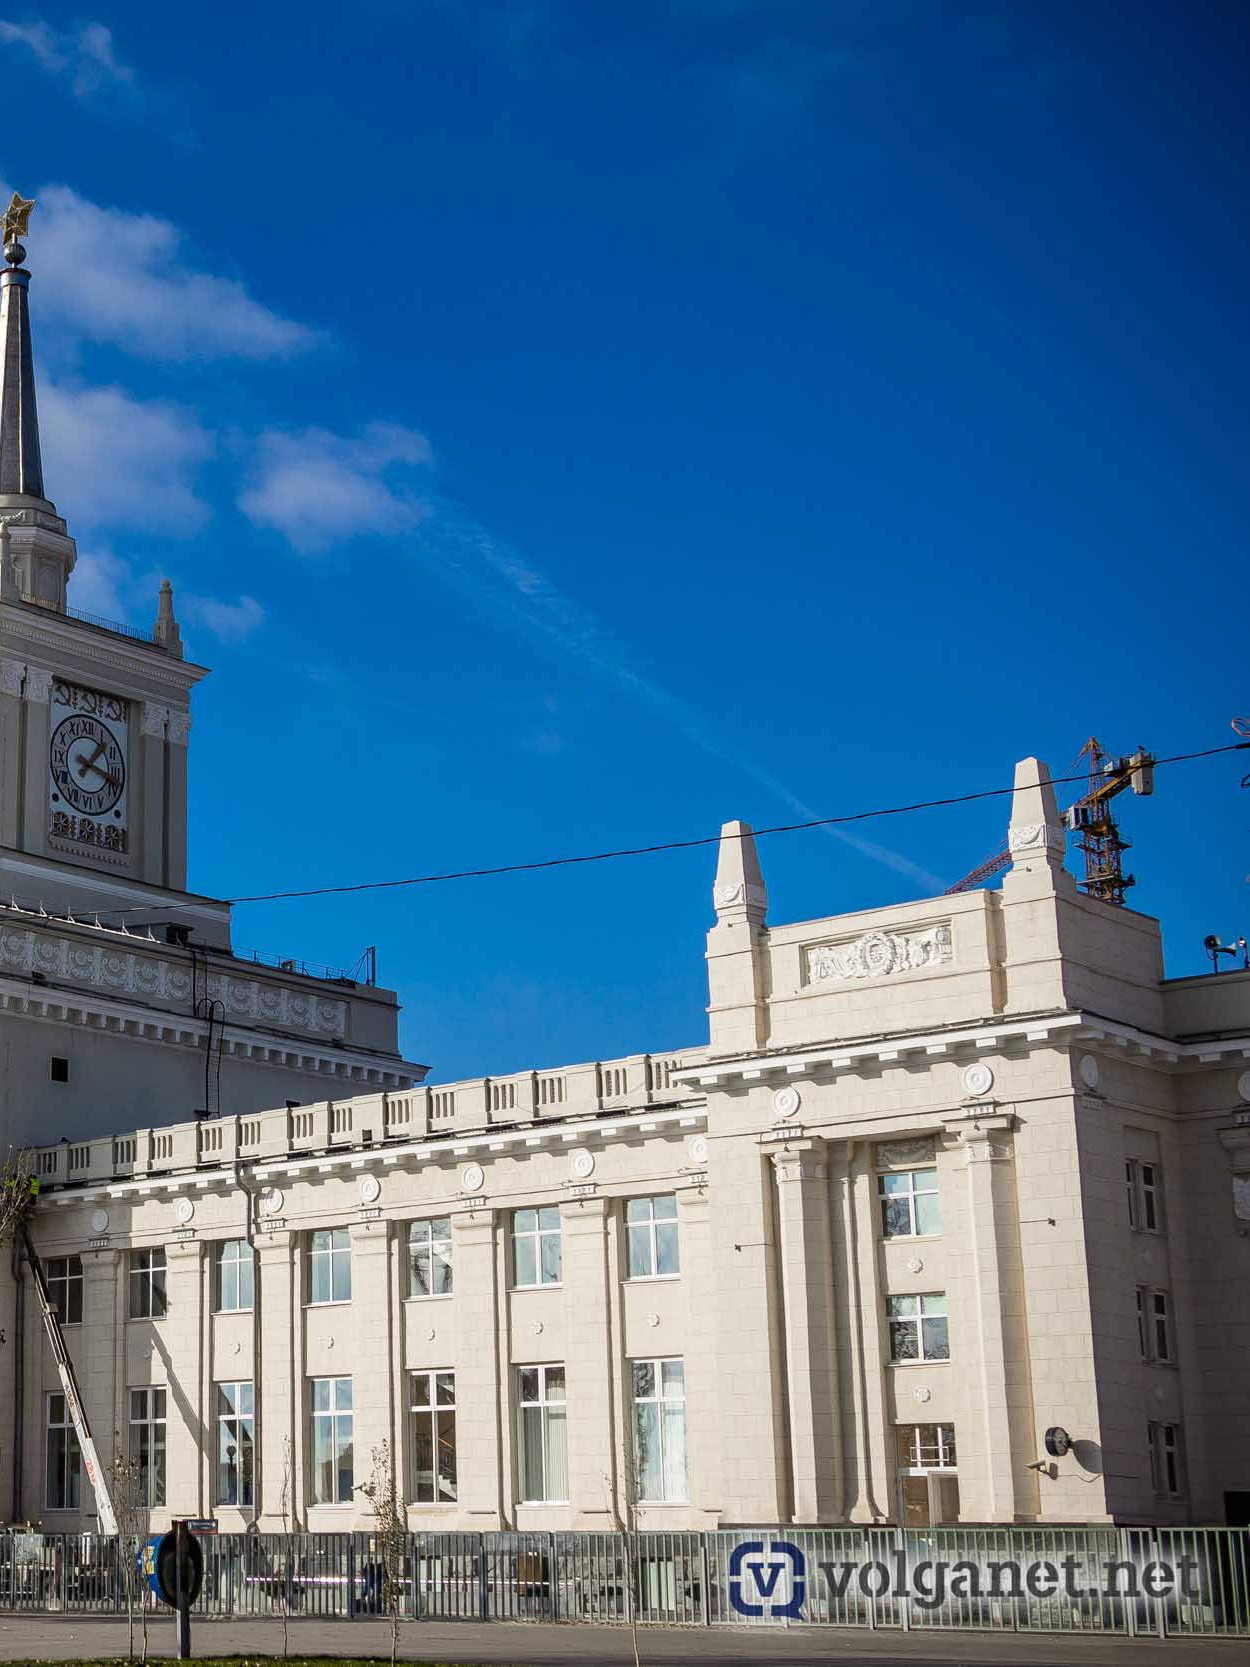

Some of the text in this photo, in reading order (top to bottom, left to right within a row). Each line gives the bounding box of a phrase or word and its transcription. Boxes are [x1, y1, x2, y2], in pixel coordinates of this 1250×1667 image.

[70, 720, 79, 736] XI
[82, 719, 94, 736] XII
[60, 731, 66, 746] X
[54, 749, 64, 764] IX
[109, 746, 116, 760] II
[55, 768, 68, 784] VIII
[111, 766, 120, 780] III
[68, 787, 78, 802] VII
[83, 794, 92, 810] VI
[97, 795, 104, 808] V
